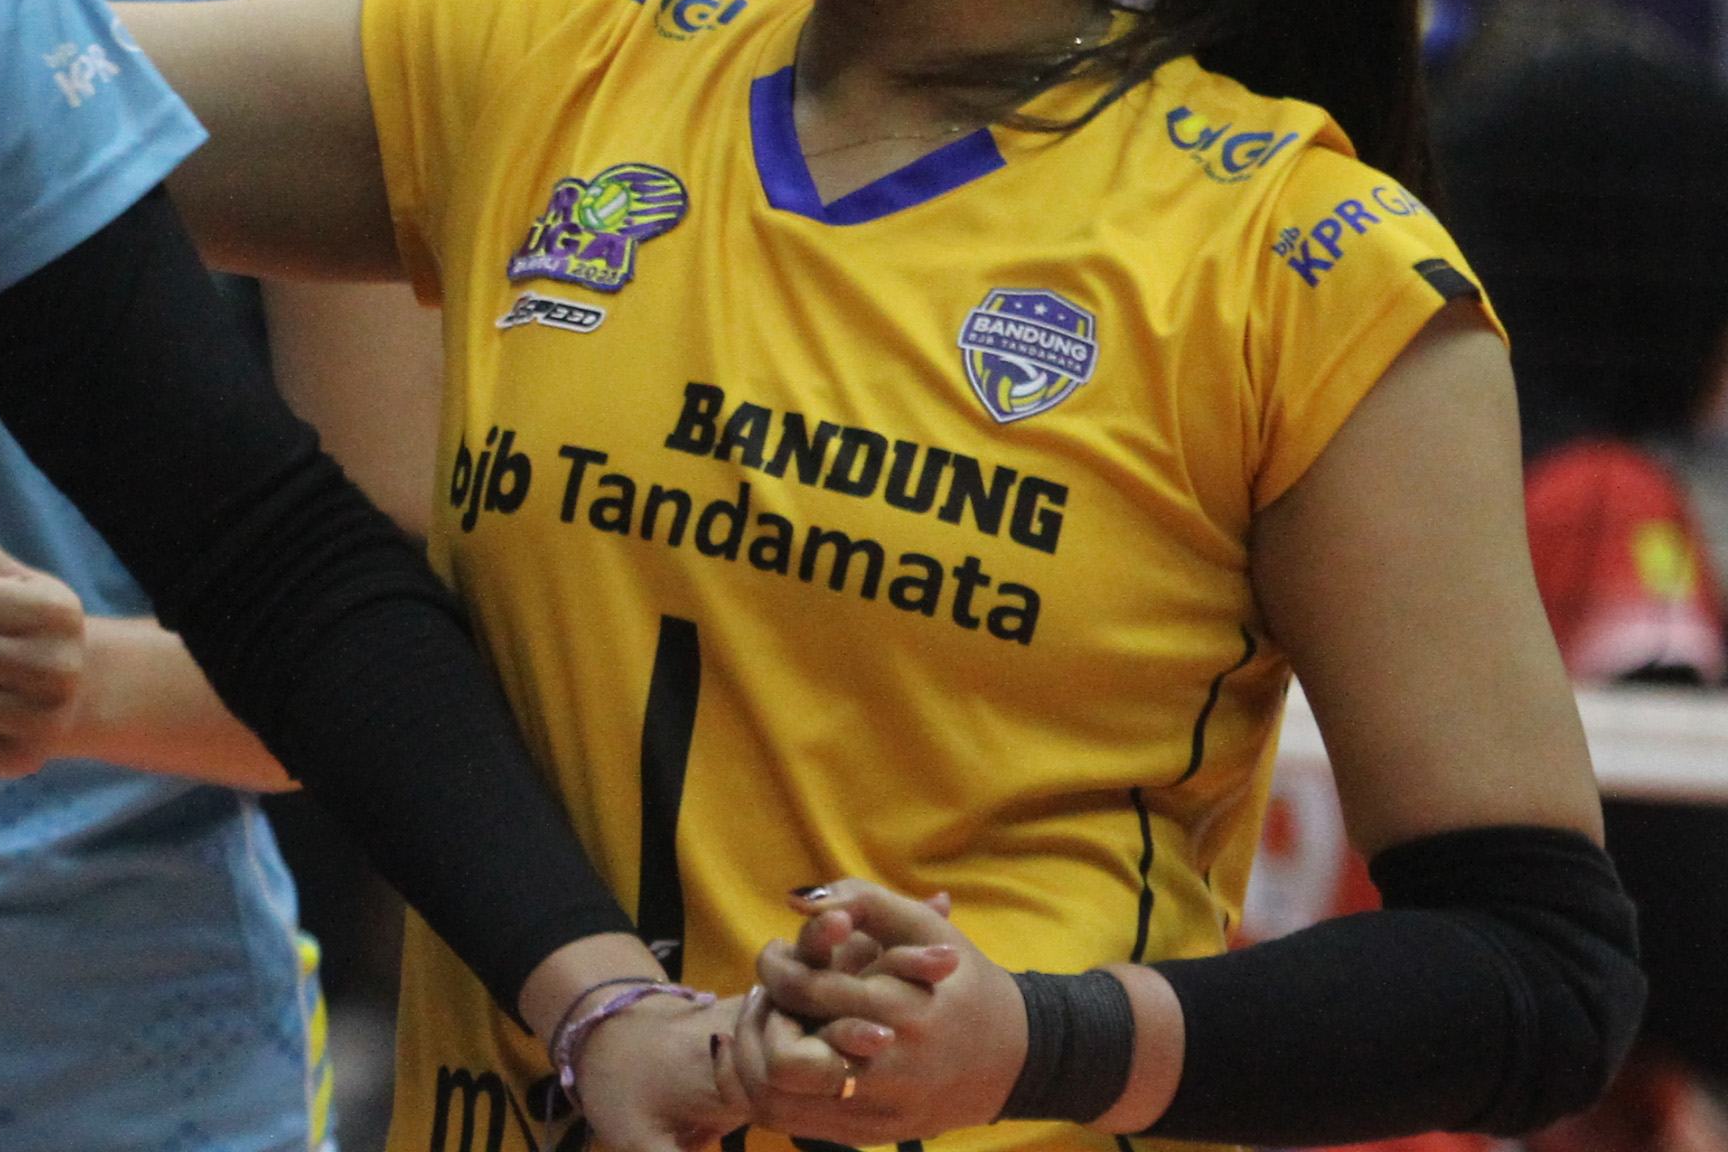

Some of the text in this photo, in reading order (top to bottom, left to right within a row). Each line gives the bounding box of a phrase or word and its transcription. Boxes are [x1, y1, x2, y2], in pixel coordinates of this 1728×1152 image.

[1271, 225, 1302, 257] bjb
[1287, 198, 1382, 289] KPR
[971, 315, 1088, 363] BANDUNG
[664, 381, 1069, 554] BANDUNG
[449, 424, 1043, 646] bjb Tandamata
